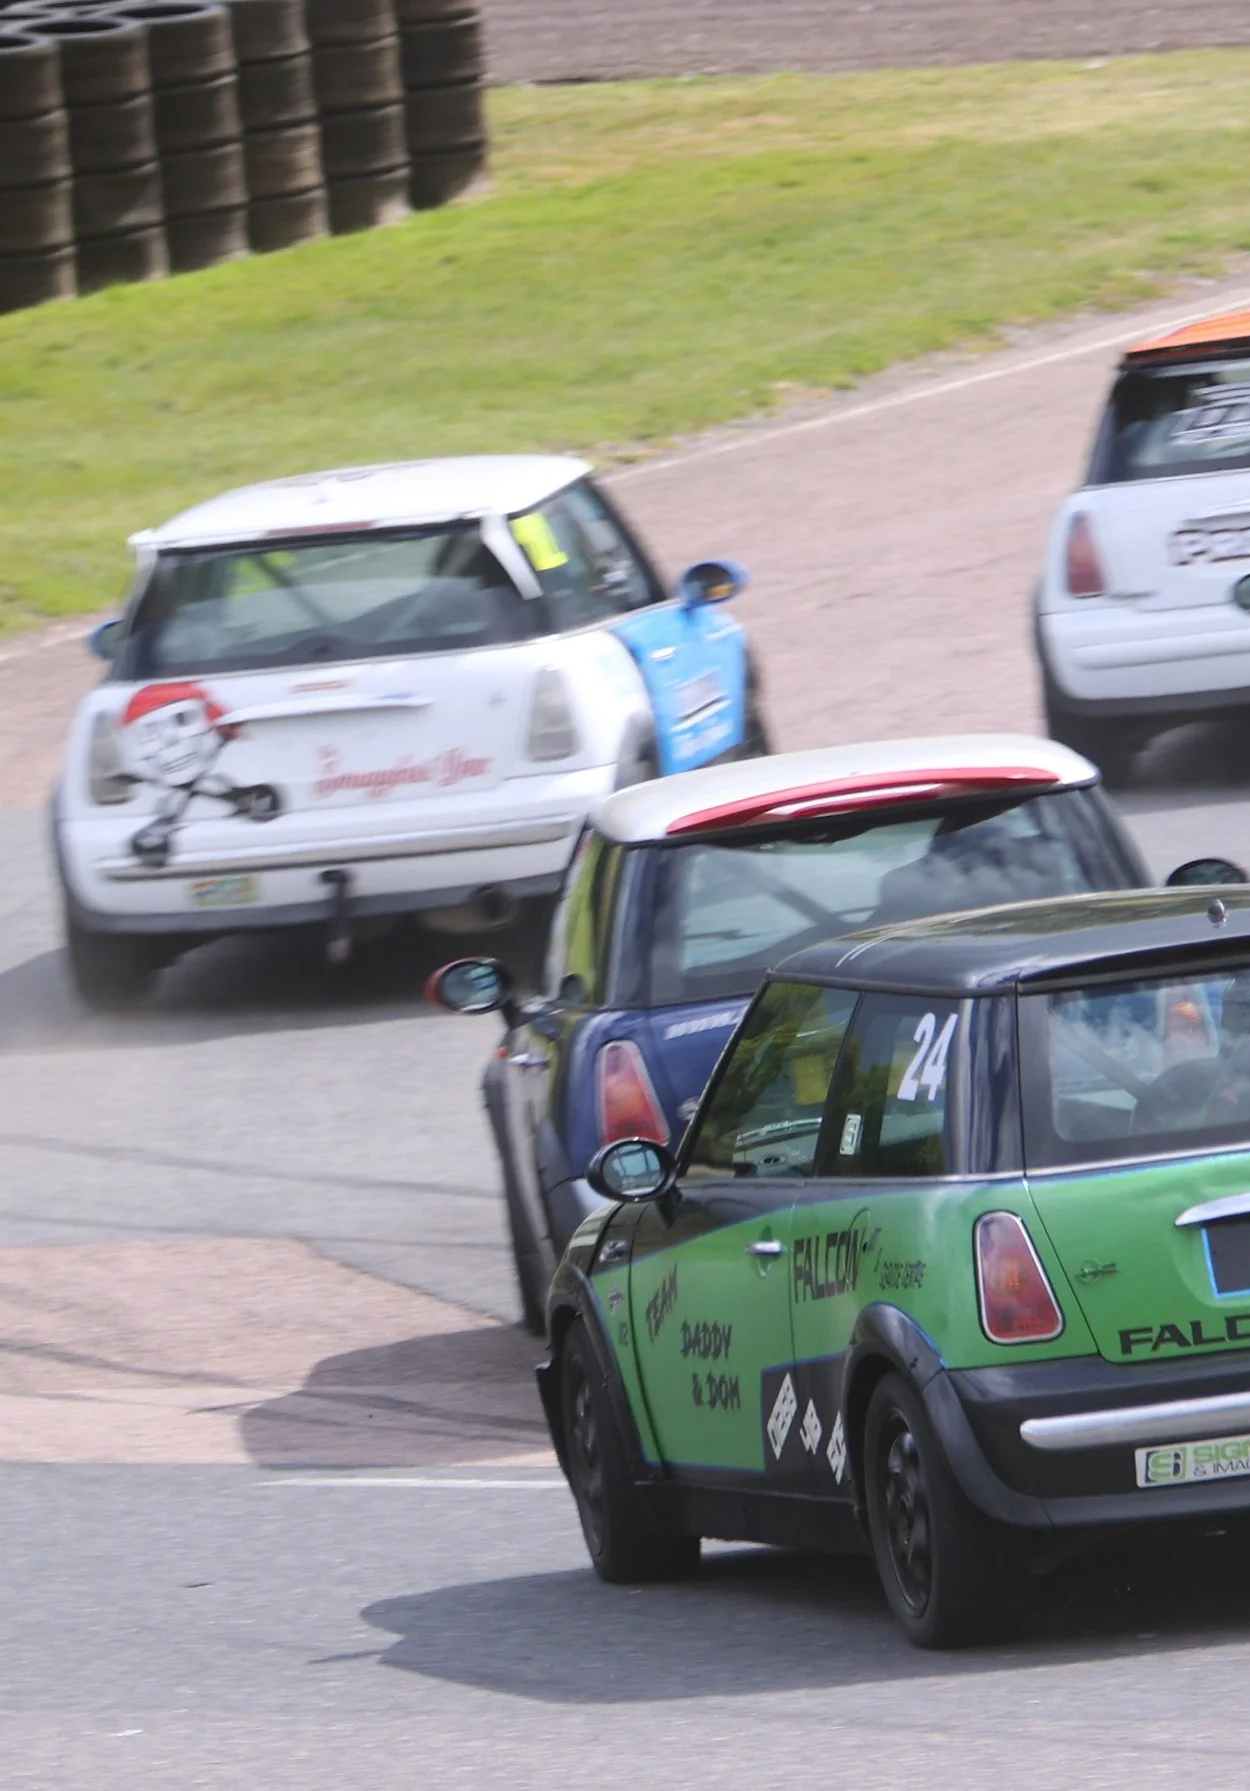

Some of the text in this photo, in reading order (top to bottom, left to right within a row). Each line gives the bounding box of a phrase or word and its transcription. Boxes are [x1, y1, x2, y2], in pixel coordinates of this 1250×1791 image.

[897, 1011, 959, 1102] 24
[680, 1316, 733, 1362] DADDY
[706, 1369, 741, 1414] DOM
